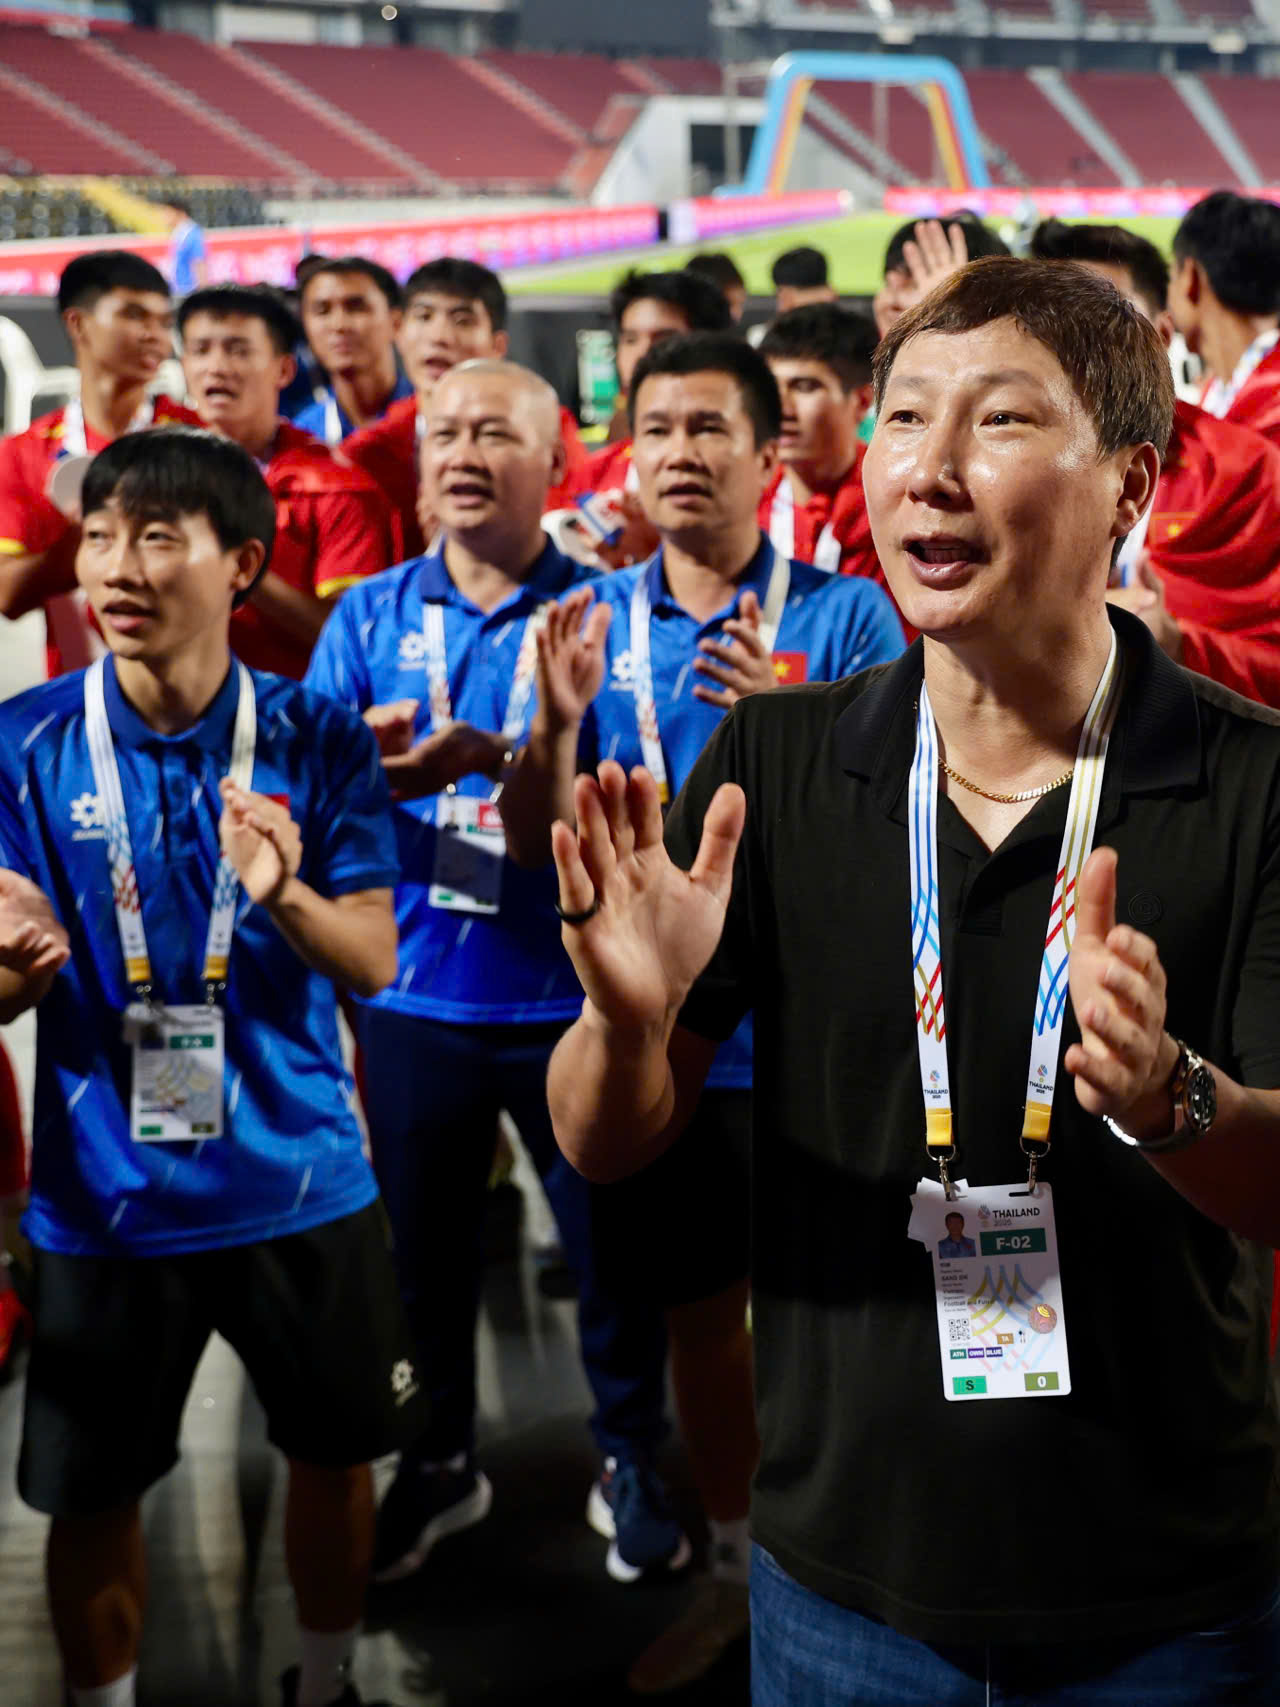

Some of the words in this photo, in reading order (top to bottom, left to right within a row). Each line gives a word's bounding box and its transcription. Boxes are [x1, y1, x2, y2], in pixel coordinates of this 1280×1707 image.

[1029, 1080, 1054, 1091] THAILAND
[992, 1207, 1040, 1218] THAILAND
[995, 1235, 1032, 1250] F-02
[965, 1379, 974, 1391] S
